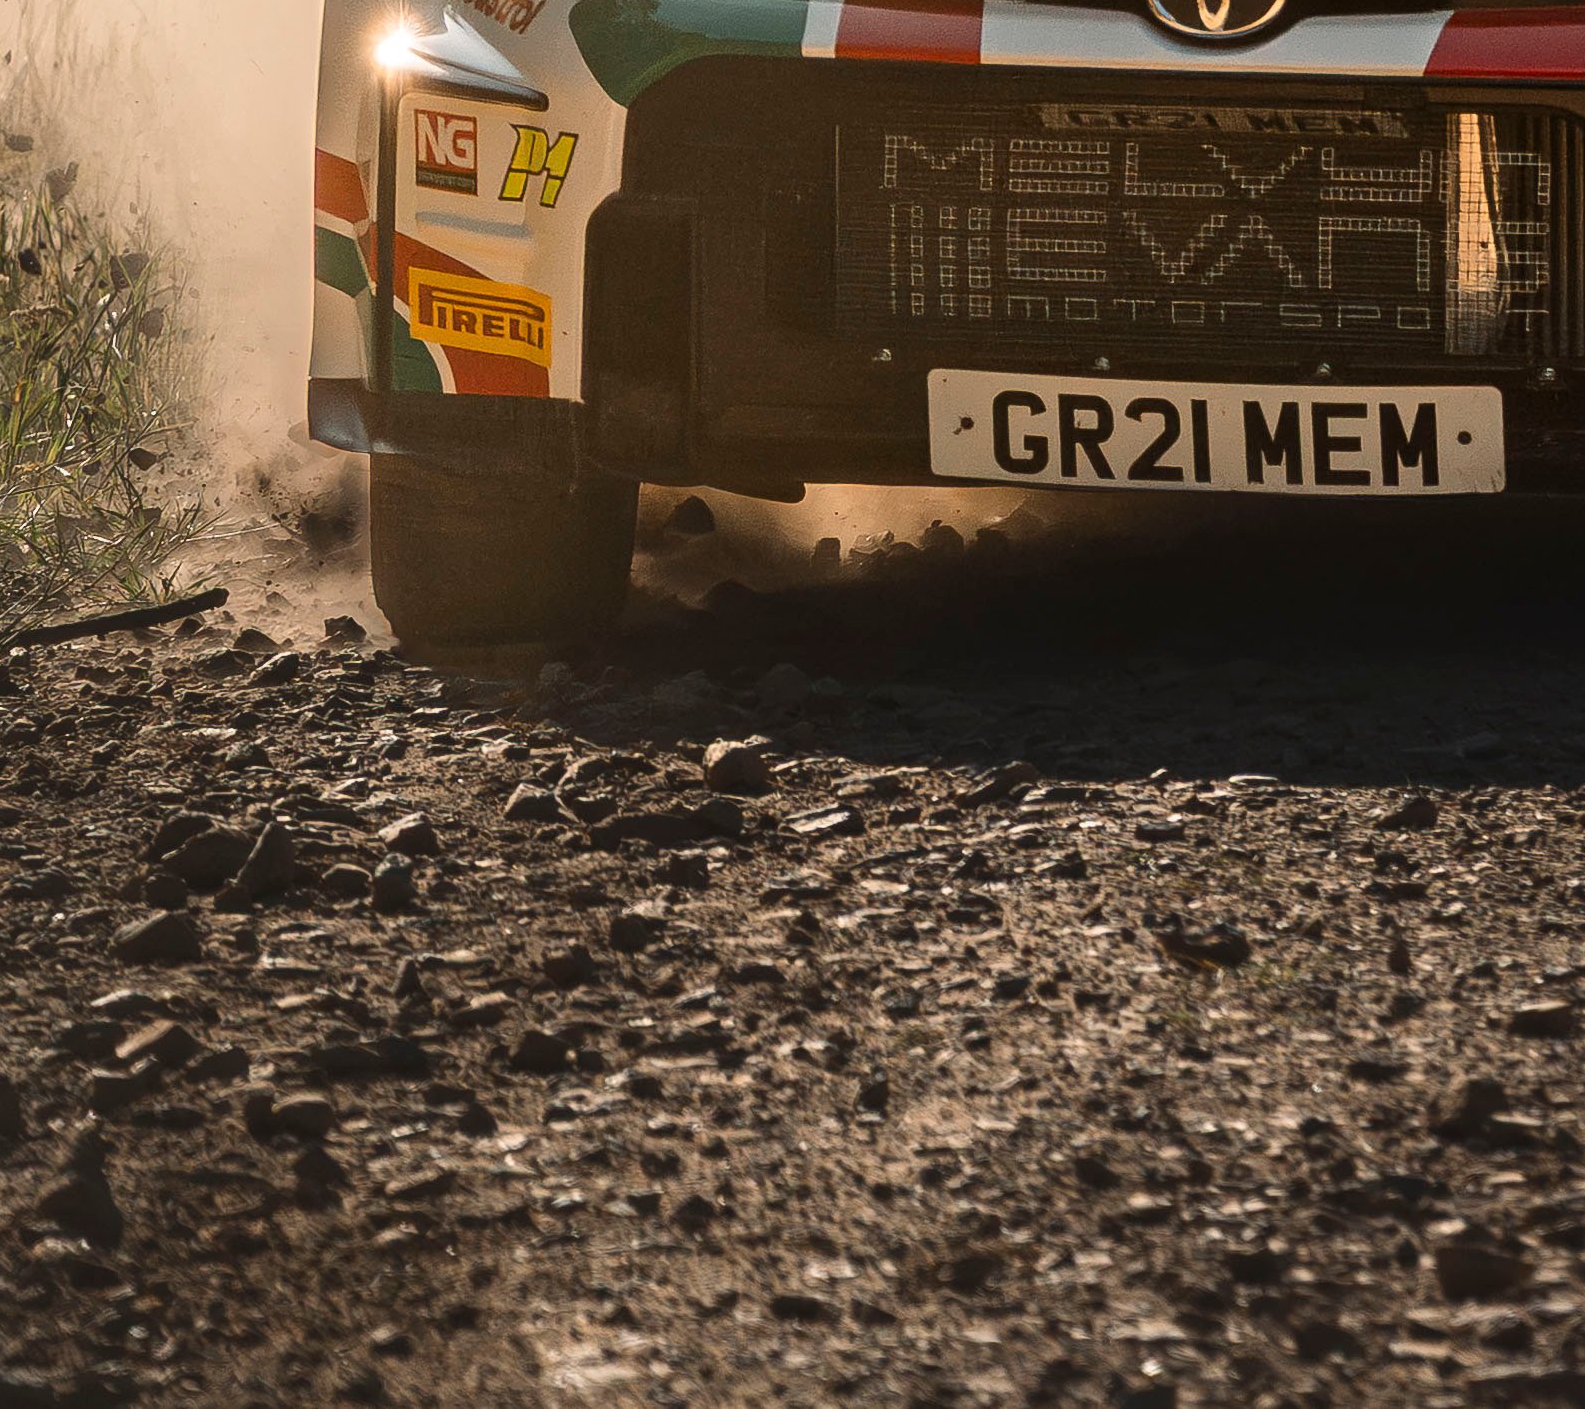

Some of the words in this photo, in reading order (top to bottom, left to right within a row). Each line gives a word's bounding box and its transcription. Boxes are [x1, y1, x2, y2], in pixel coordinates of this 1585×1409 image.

[417, 112, 475, 170] NG
[498, 123, 579, 208] P1
[419, 283, 545, 350] PIRELLI
[991, 389, 1211, 484] GR21
[1242, 399, 1440, 487] MEM
